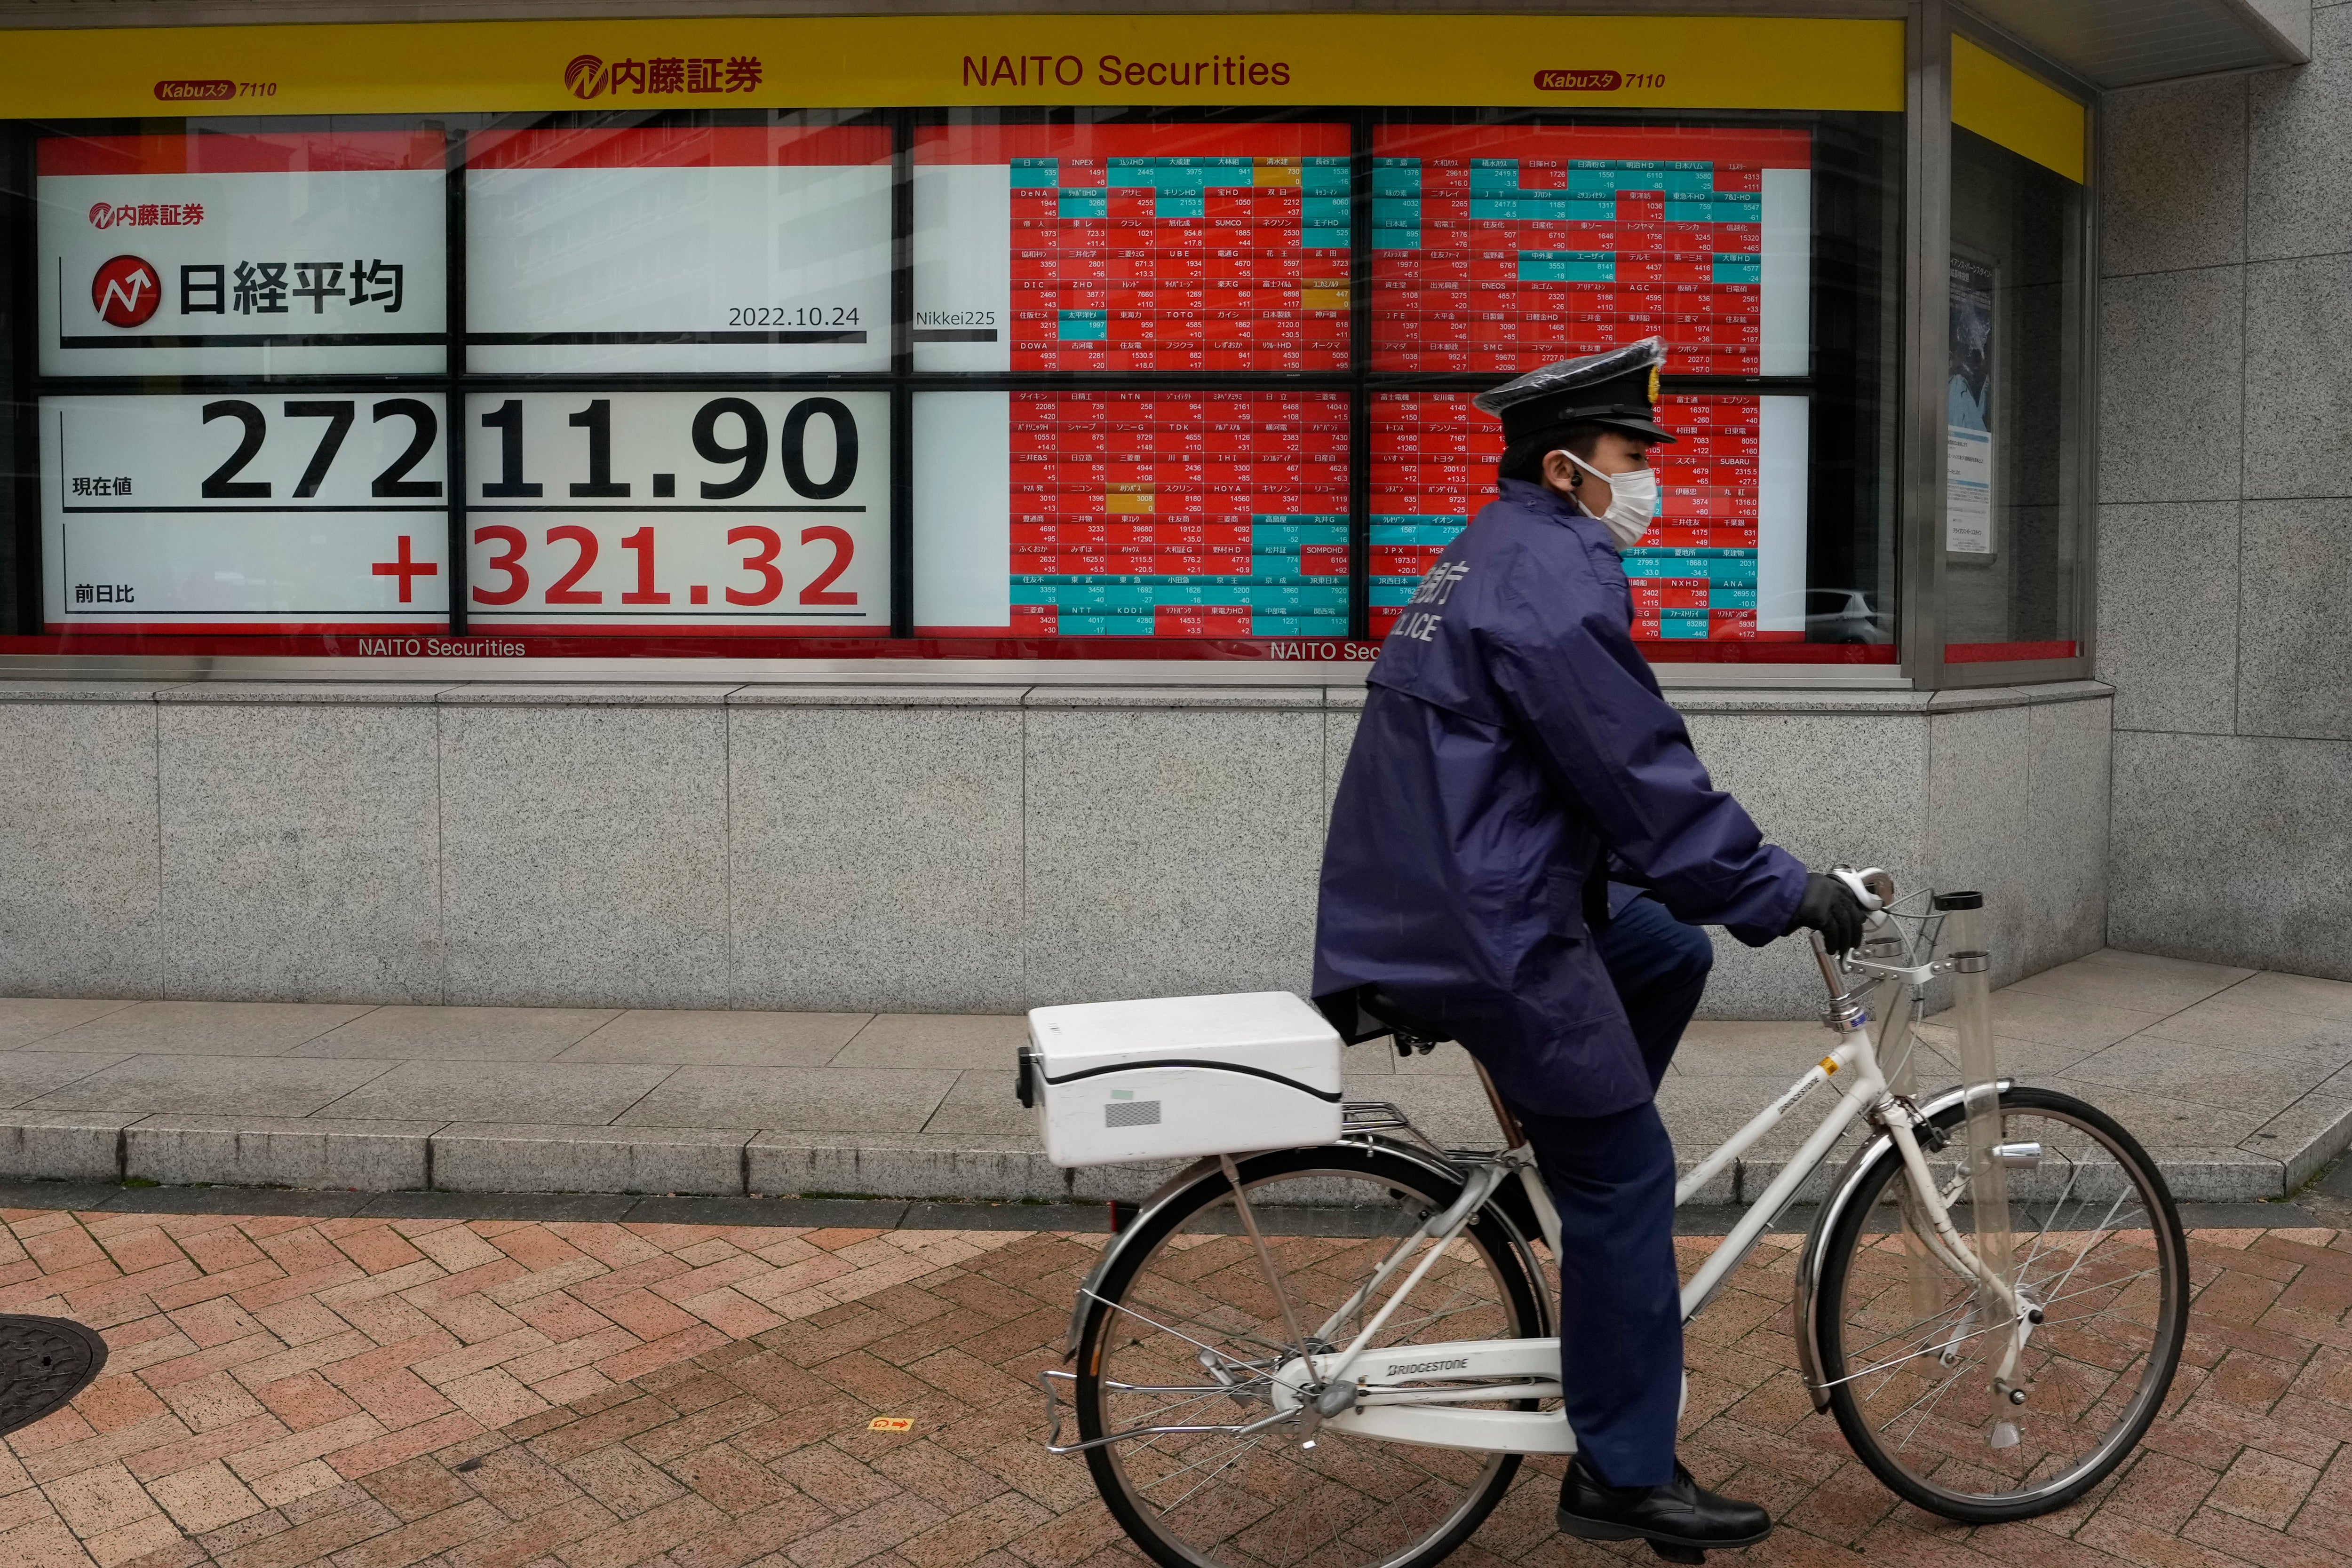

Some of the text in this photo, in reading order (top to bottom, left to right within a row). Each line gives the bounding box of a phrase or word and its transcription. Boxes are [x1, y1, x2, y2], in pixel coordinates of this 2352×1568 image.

[611, 56, 763, 95] 内藤証券
[963, 54, 1290, 87] NAITO Securities
[1542, 73, 1666, 88] Kabuスタ 7110
[162, 83, 277, 98] Kabuスタ 7110
[115, 204, 205, 226] 内藤証券
[180, 259, 404, 315] 日経平均
[729, 307, 859, 326] 2022.10.24
[916, 311, 995, 325] Nikkei225
[72, 476, 133, 496] 現在値
[75, 584, 135, 603] 前日比
[359, 638, 525, 656] NAITO Securities
[1271, 641, 1336, 660] NAITO
[1386, 1358, 1469, 1377] BRIDGESTONE
